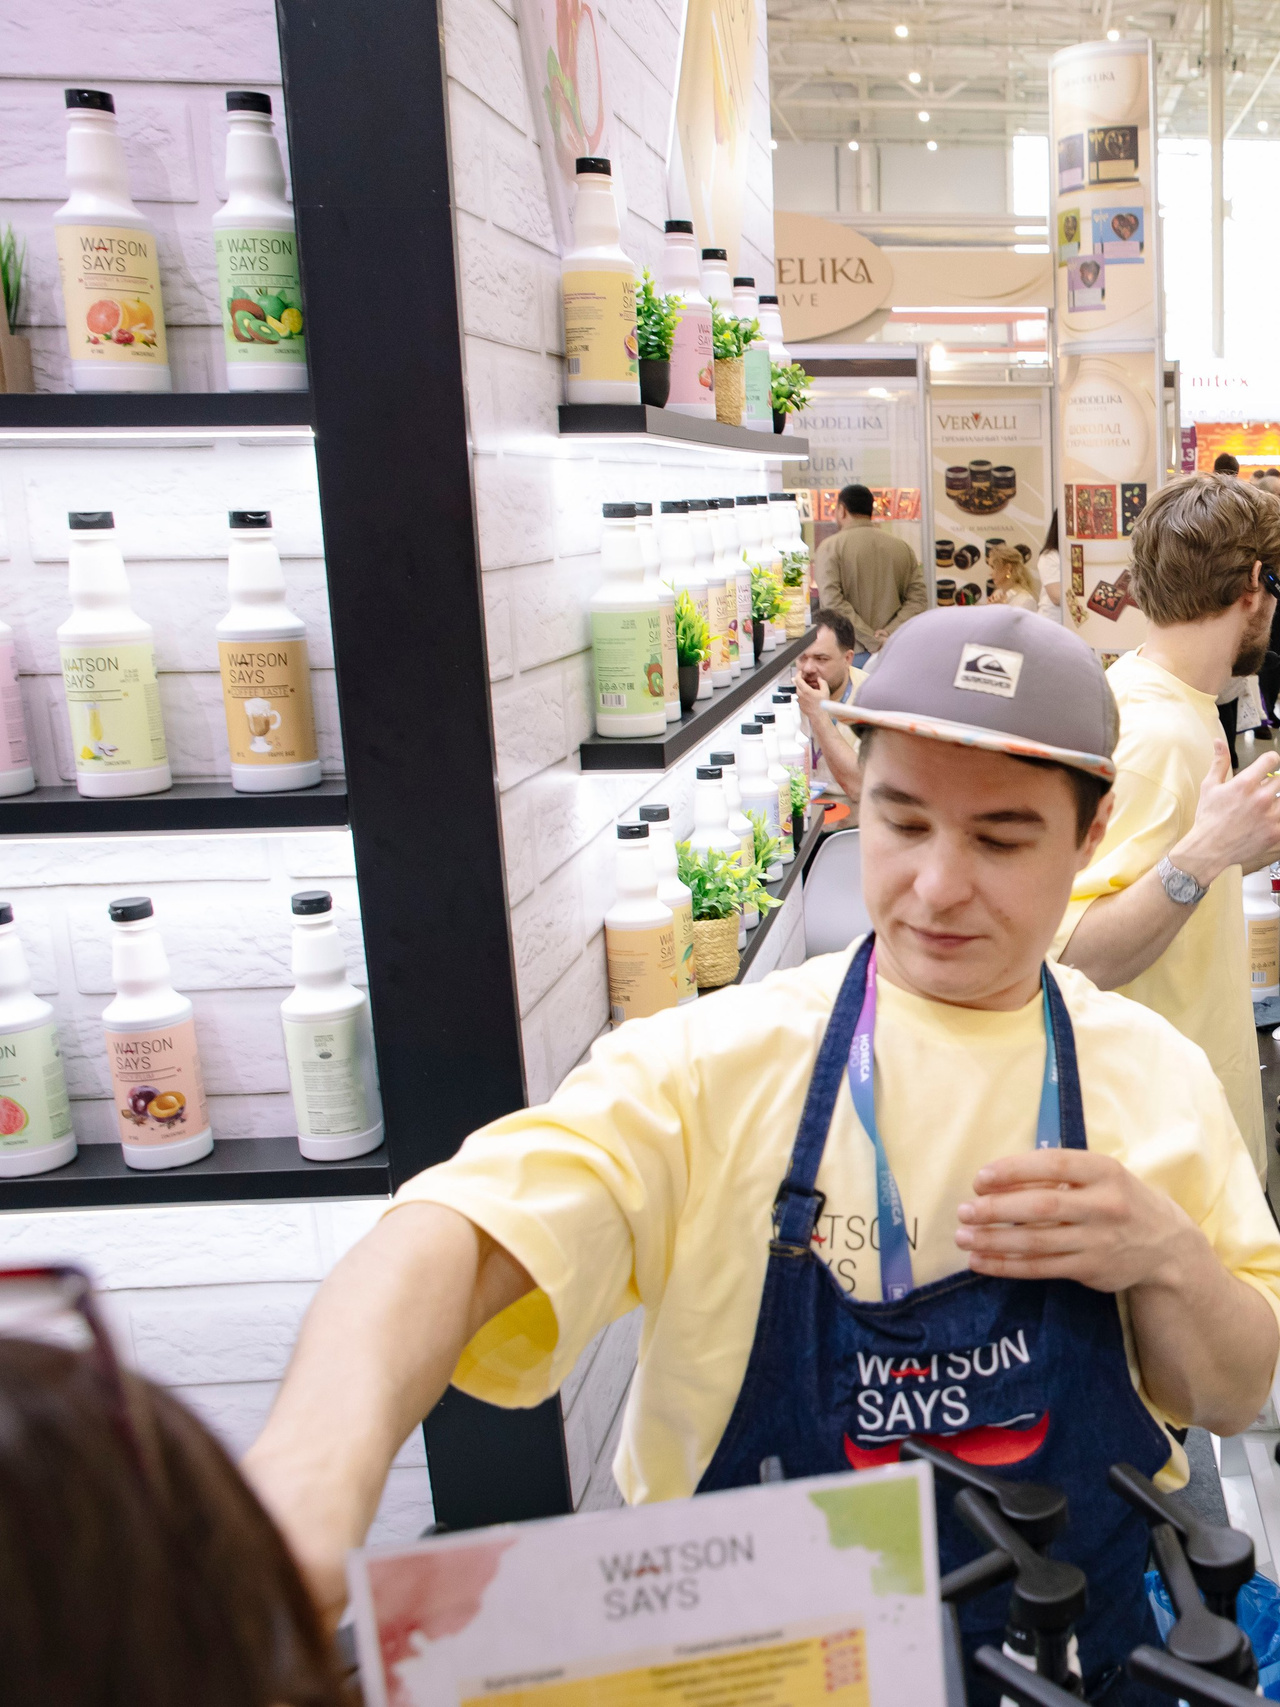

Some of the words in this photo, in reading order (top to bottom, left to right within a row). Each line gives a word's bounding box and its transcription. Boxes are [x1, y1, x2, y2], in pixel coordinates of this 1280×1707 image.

[80, 236, 148, 259] WATSON
[226, 237, 293, 256] WATSON
[82, 254, 127, 273] SAYS
[229, 255, 270, 272] SAYS
[777, 257, 875, 285] ELIKA
[782, 293, 819, 307] IVE
[794, 415, 883, 430] OKODELIKA
[937, 411, 1017, 430] VERVALLI
[799, 457, 854, 473] DUBAI
[64, 656, 119, 673] WATSON
[227, 652, 288, 668] WATSON
[66, 673, 96, 689] SAYS
[229, 669, 265, 684] SAYS
[231, 687, 260, 697] COFFEE
[262, 687, 288, 696] TASTE
[113, 1036, 174, 1056] WATSON
[116, 1055, 152, 1071] SAYS
[860, 1033, 871, 1083] HORECA
[856, 1329, 1031, 1387] WATSON
[857, 1385, 971, 1432] SAYS
[600, 1532, 757, 1586] WATSON
[602, 1576, 702, 1623] SAYS
